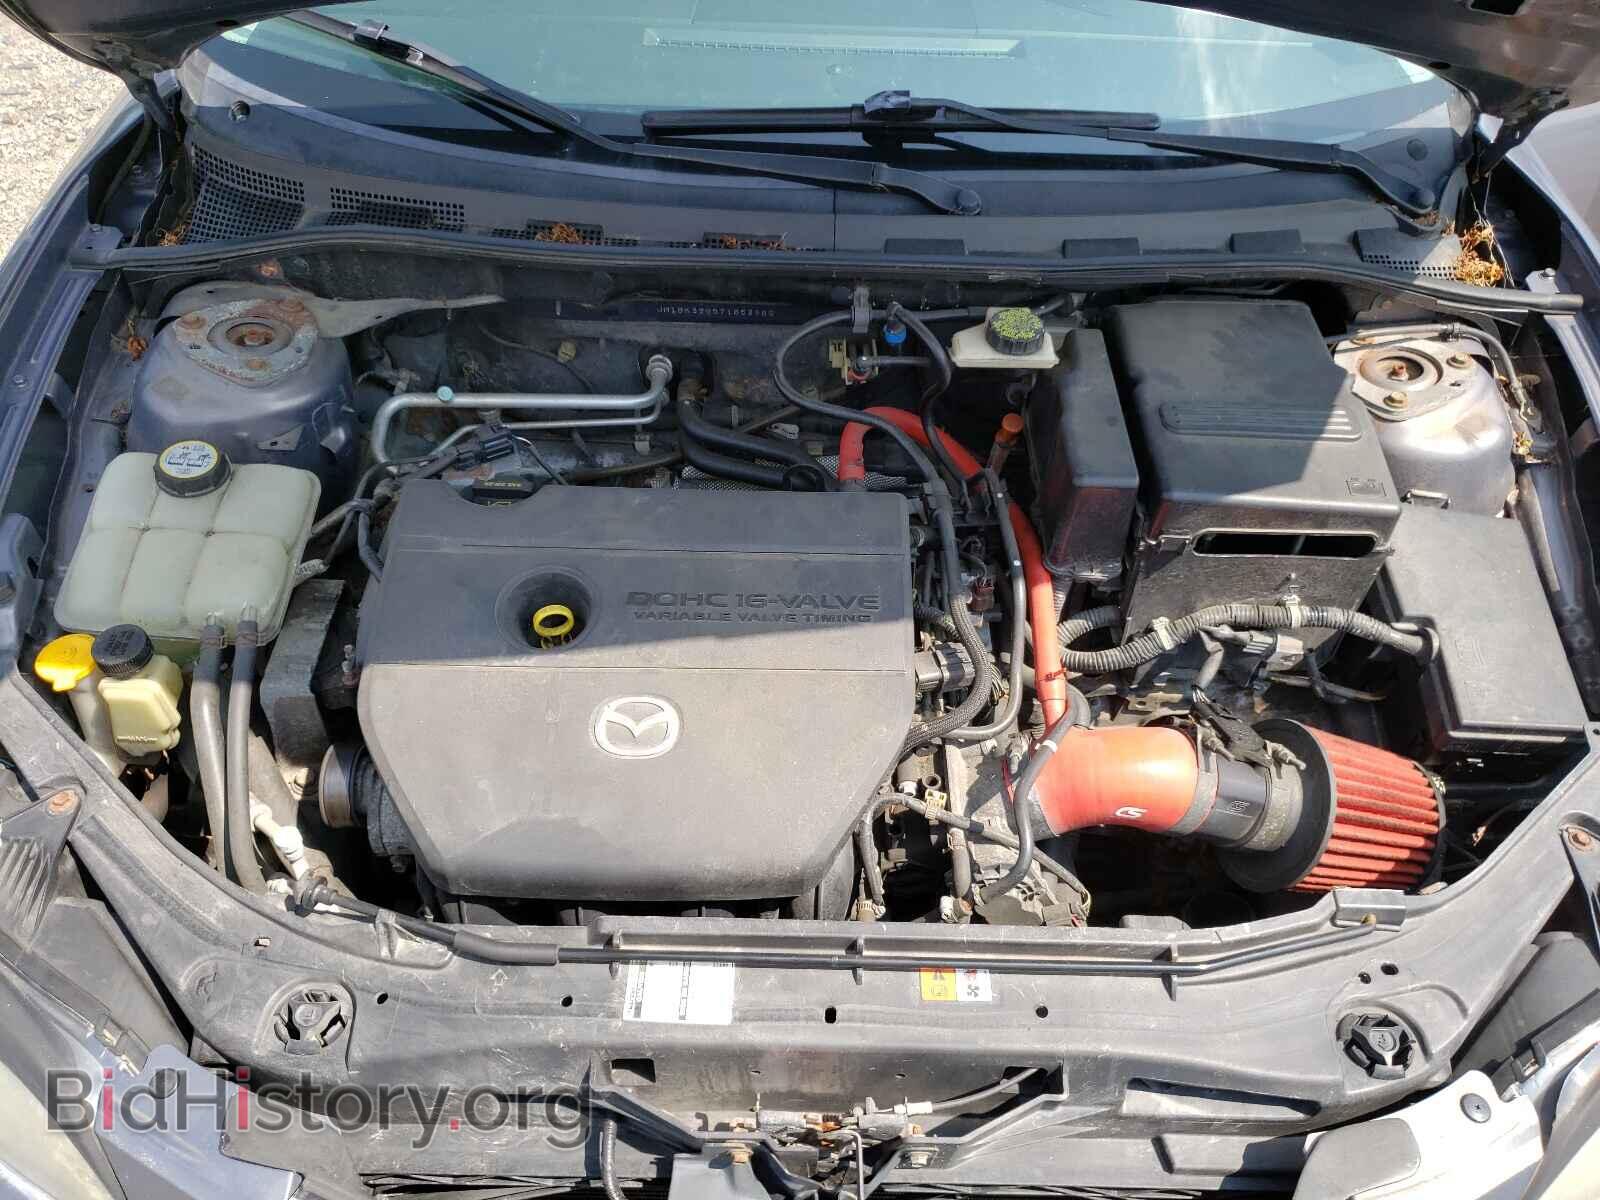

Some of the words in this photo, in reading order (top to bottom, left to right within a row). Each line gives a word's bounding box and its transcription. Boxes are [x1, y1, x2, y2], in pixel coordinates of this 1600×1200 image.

[625, 592, 729, 608] DOHC
[735, 593, 881, 610] 16-VALVE
[633, 611, 732, 622] VARIABLE
[737, 612, 797, 623] VALVE
[802, 613, 873, 624] TIMING
